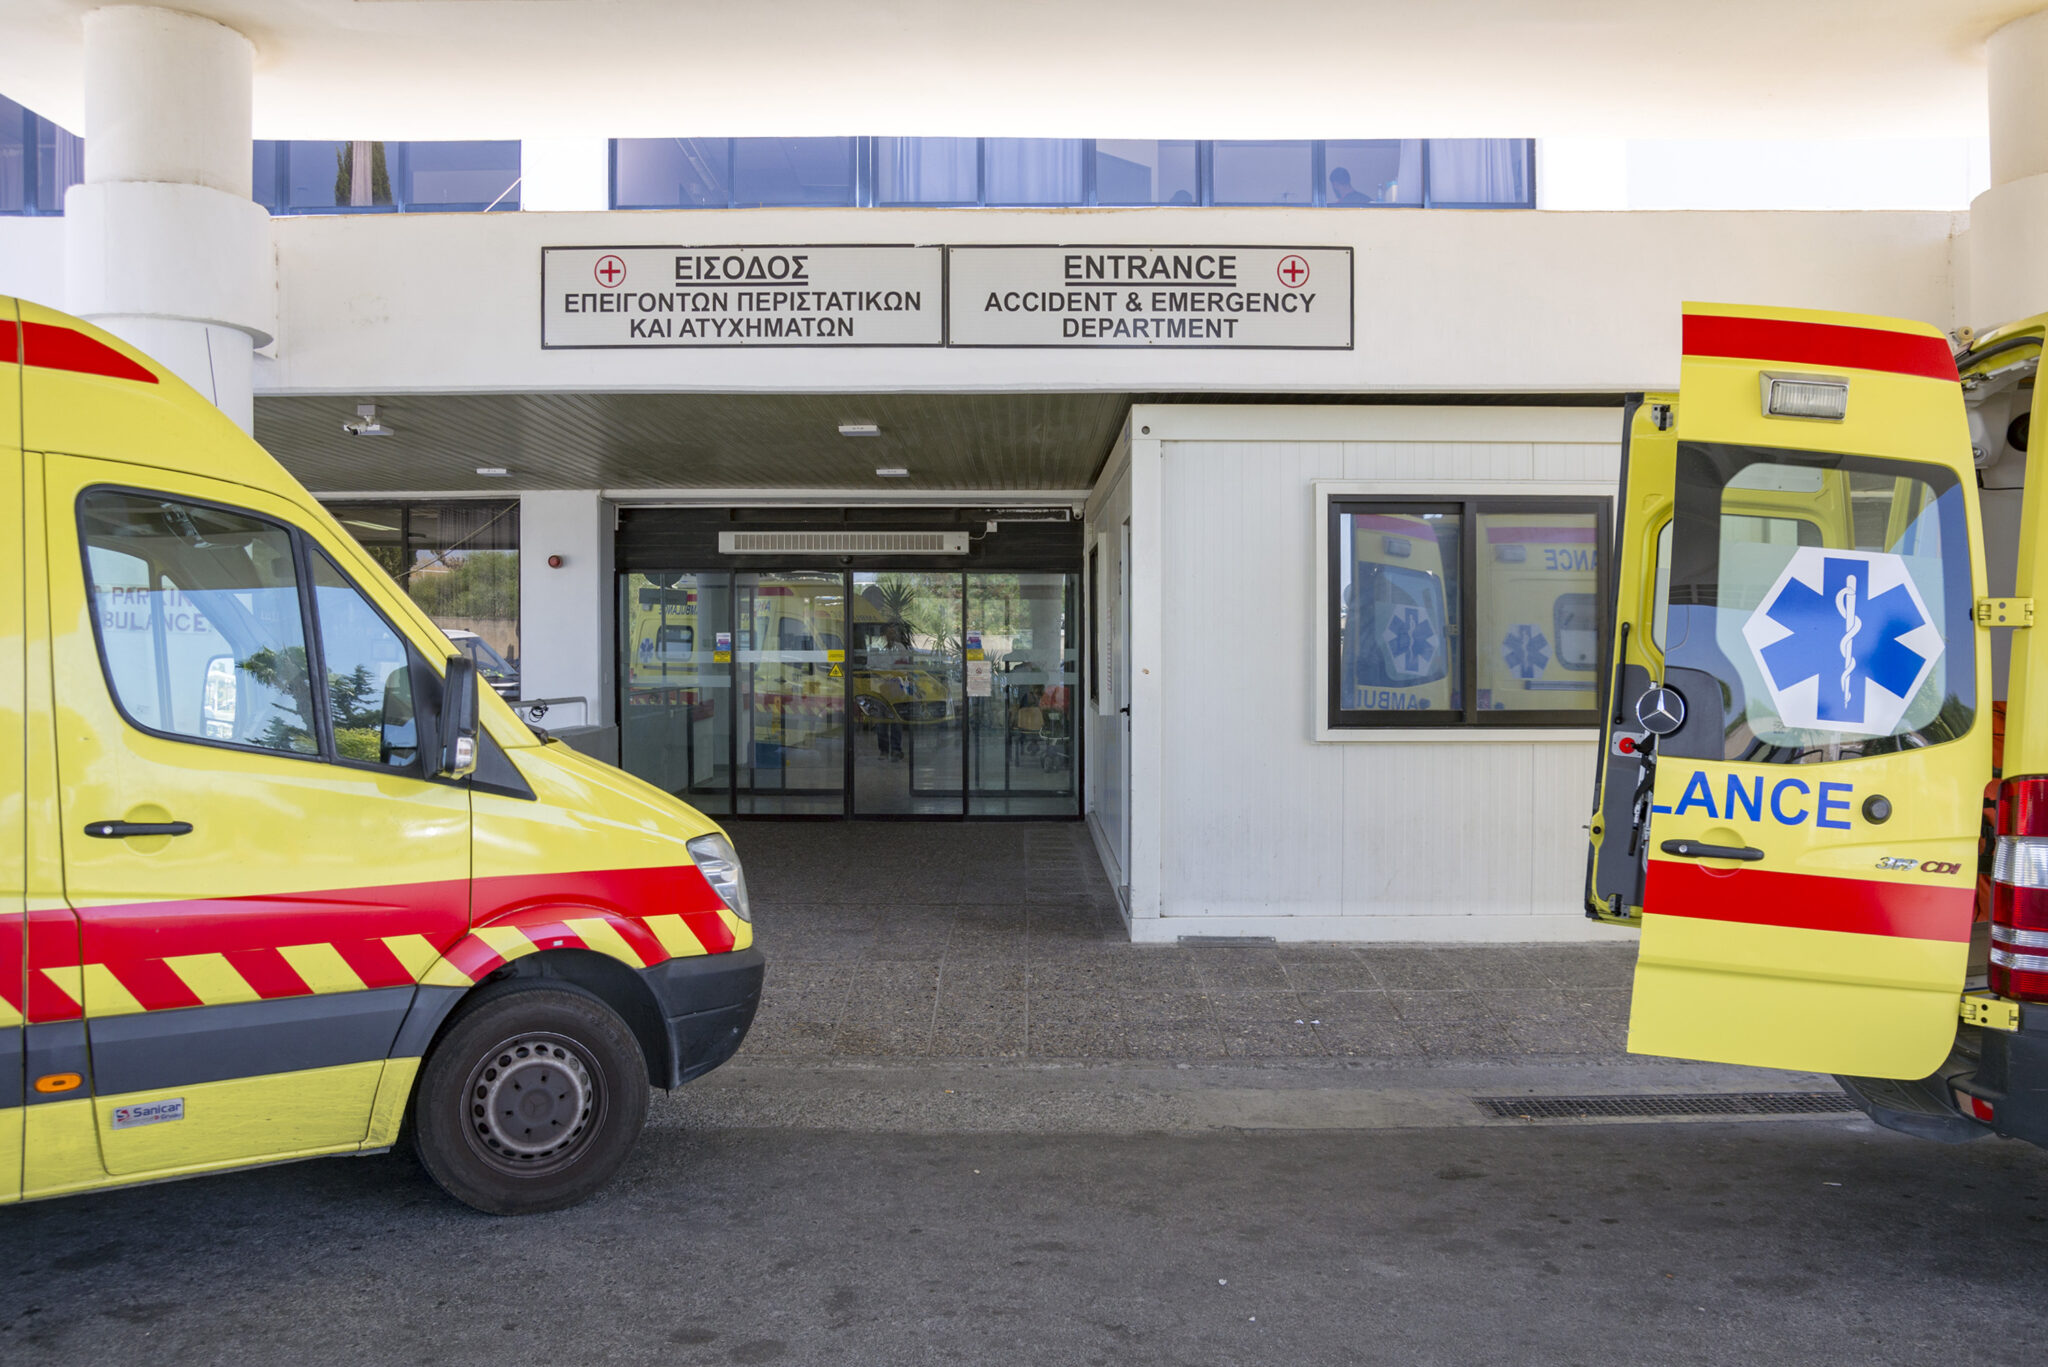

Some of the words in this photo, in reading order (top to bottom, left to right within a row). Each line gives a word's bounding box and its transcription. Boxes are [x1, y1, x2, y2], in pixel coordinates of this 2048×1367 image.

[675, 255, 808, 281] ΕΙΣΟΔΟΣ
[1064, 255, 1237, 280] ENTRANCE
[565, 292, 728, 313] ΕΠΕΙΓΟΝΤΩΝ
[737, 291, 921, 312] ΠΕΡΙΣΤΑΤΙΚΩΝ
[984, 292, 1118, 312] ACCIDENT
[1125, 292, 1143, 312] &
[1151, 292, 1316, 313] EMERGENCY
[630, 318, 671, 338] ΚΑΙ
[679, 317, 854, 338] ΑΤΥΧΗΜΑΤΩΝ
[1063, 318, 1239, 338] DEPARTMENT
[1920, 860, 1962, 874] CDI
[133, 1103, 181, 1117] Sanicar
